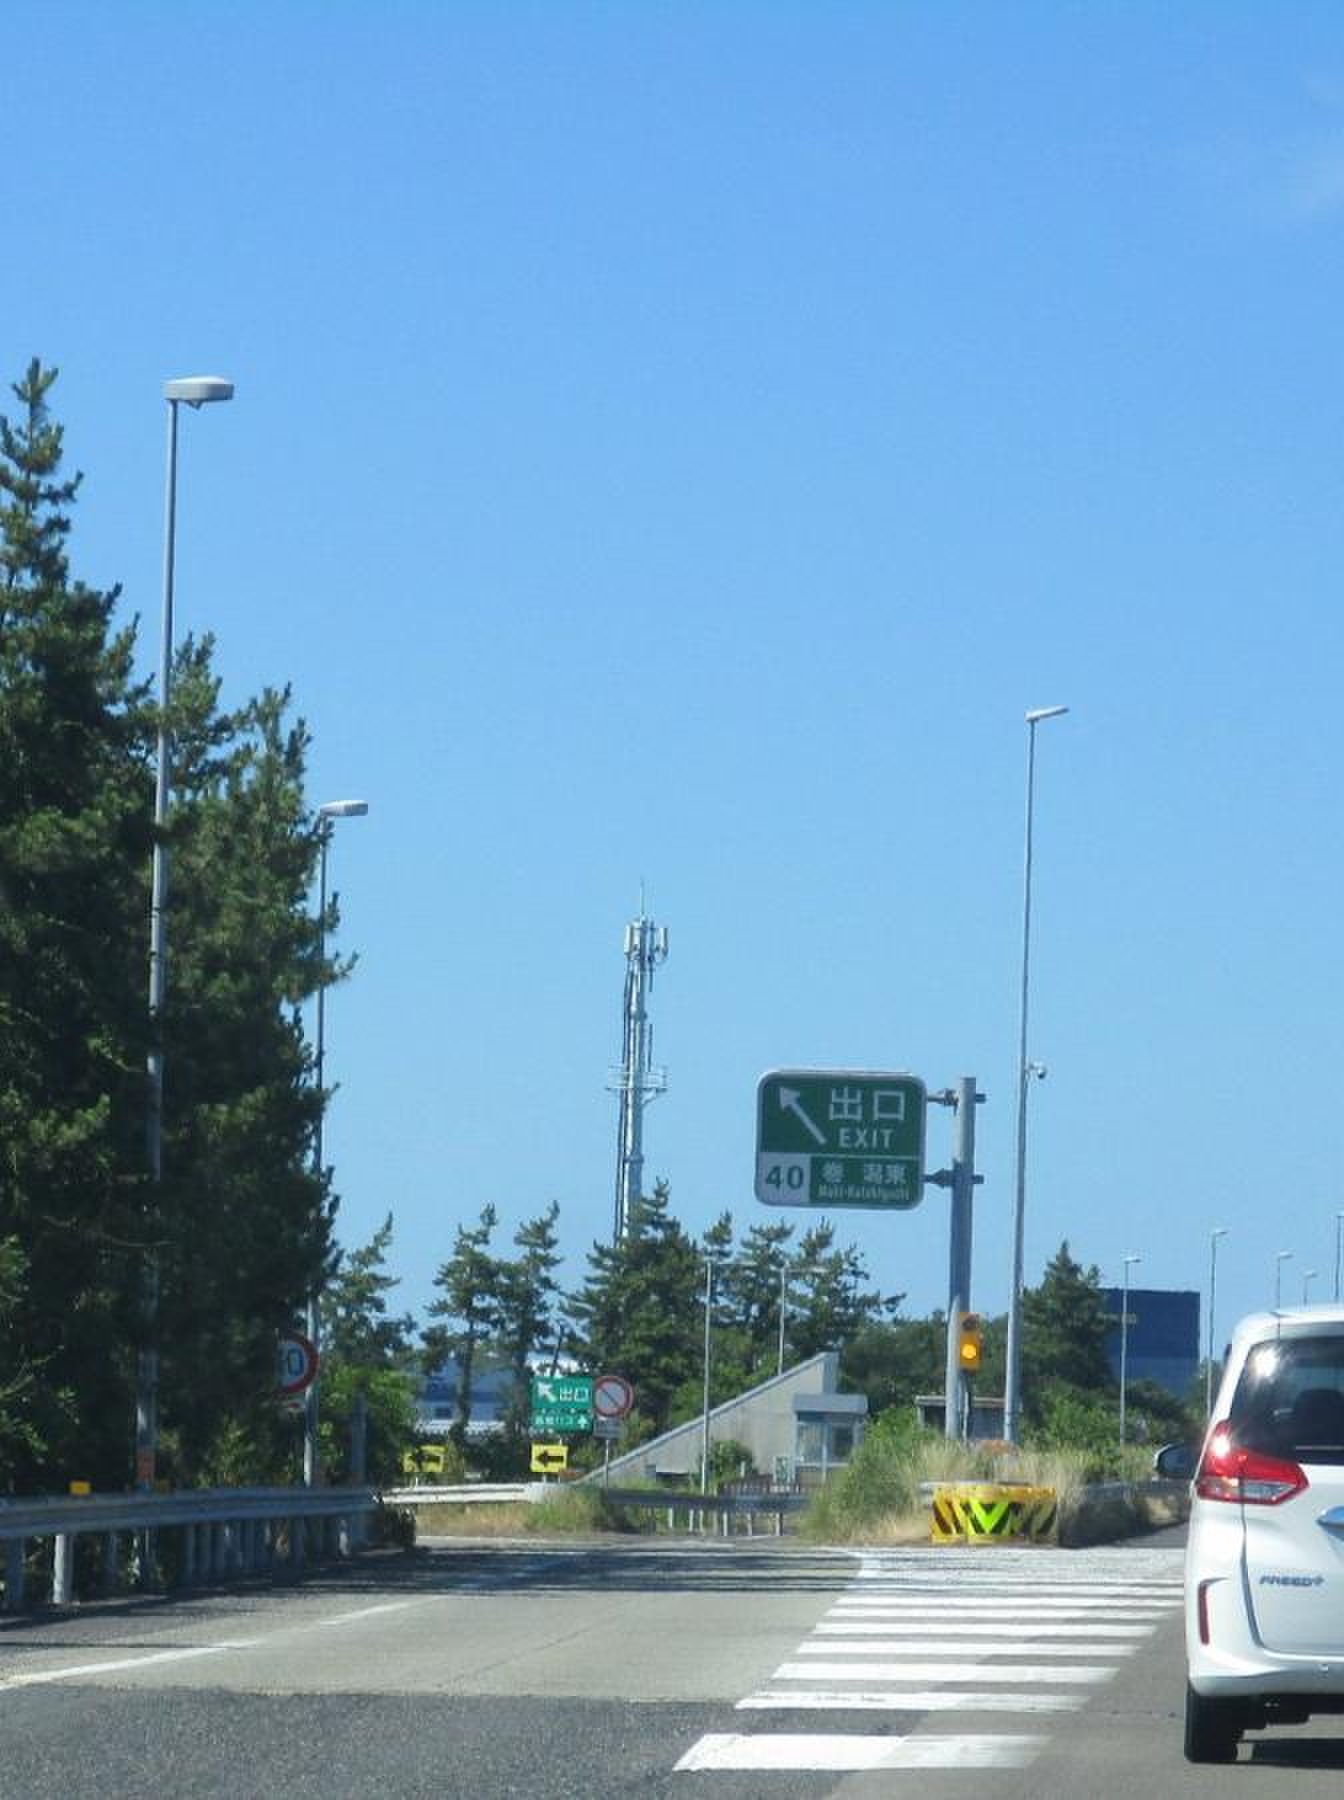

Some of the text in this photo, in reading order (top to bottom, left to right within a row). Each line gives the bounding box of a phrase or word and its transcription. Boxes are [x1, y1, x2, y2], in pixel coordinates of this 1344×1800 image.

[828, 1086, 905, 1121] 出口
[838, 1127, 895, 1148] EXIT
[765, 1165, 805, 1190] 40
[559, 1386, 590, 1402] 出口
